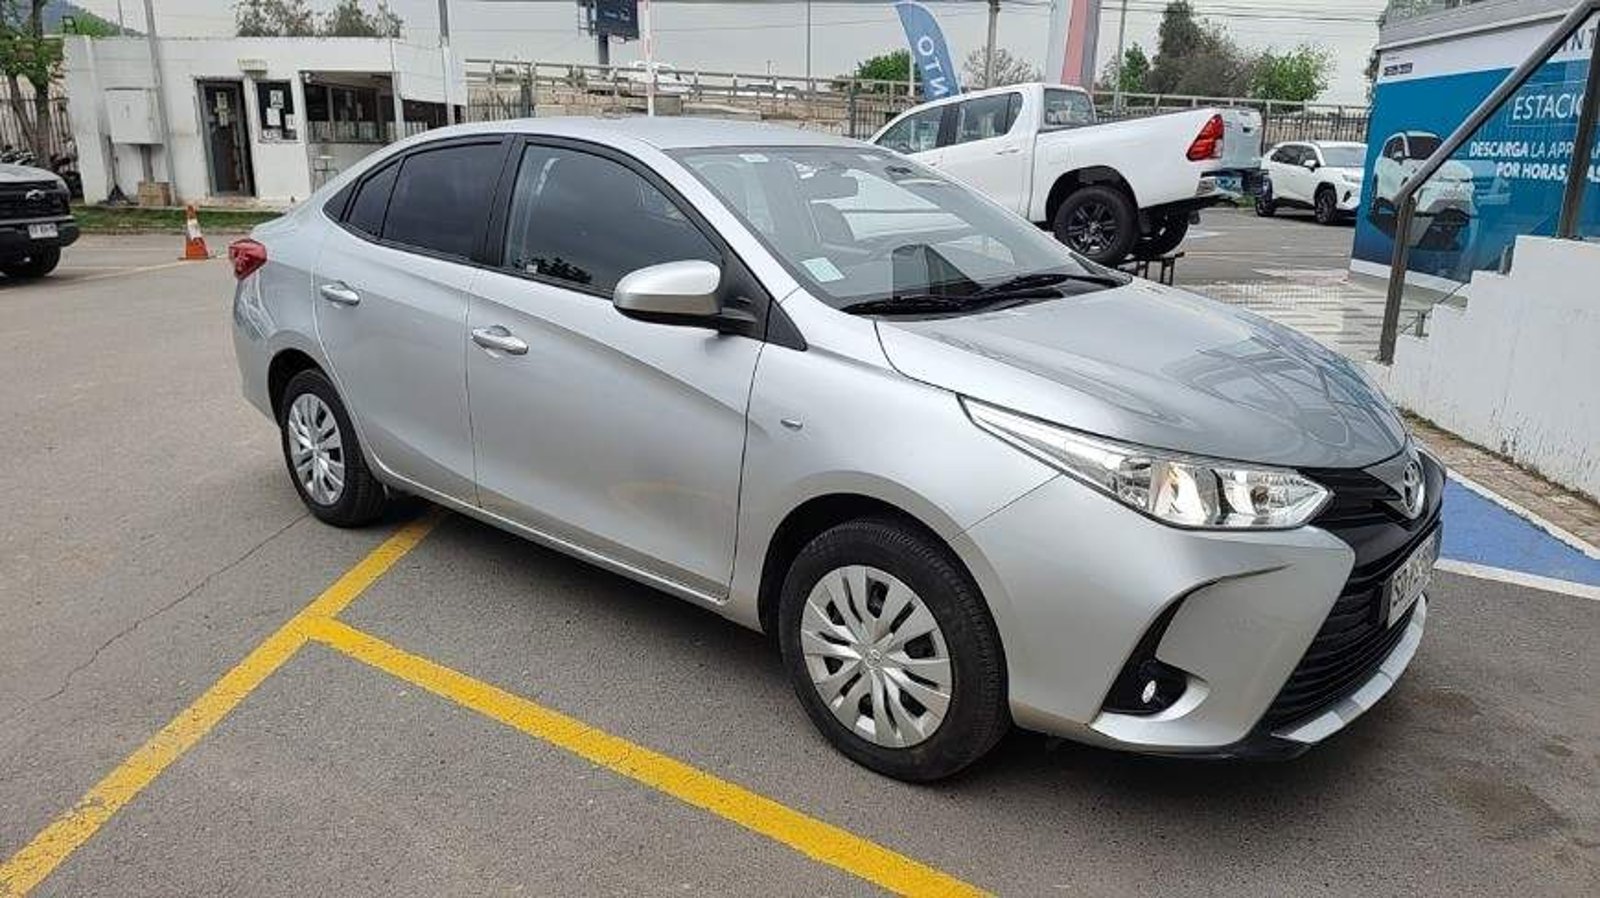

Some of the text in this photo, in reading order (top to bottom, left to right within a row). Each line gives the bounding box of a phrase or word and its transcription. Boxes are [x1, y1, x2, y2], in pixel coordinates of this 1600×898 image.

[1469, 141, 1528, 158] DESCARGA
[1530, 142, 1545, 158] LA
[1496, 162, 1520, 178] POR
